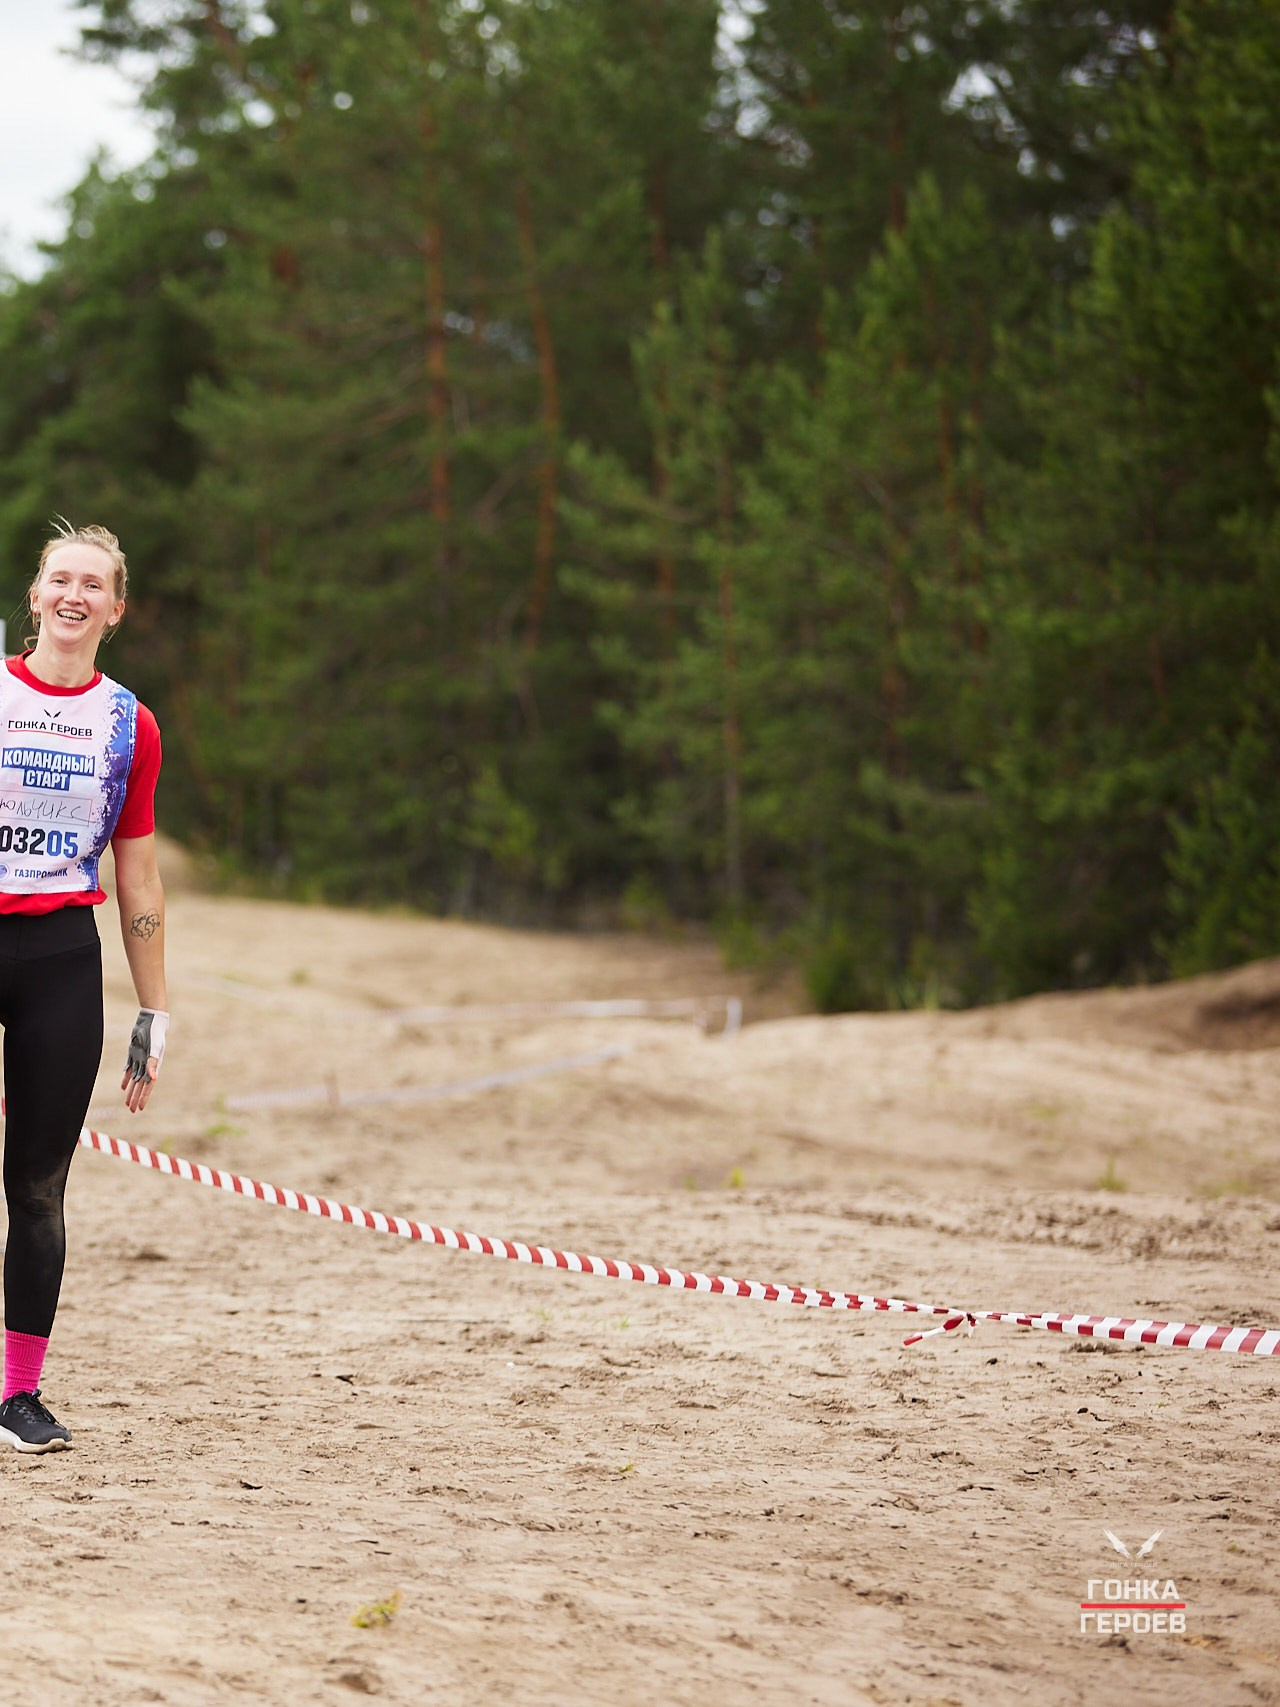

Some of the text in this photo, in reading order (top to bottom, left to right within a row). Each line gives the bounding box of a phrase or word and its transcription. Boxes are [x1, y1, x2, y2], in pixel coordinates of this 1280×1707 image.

[8, 720, 93, 737] ГОНКА ГЕРОЕВ
[3, 749, 94, 775] КОМАНДНЫЙ
[25, 769, 69, 790] СТАРТ
